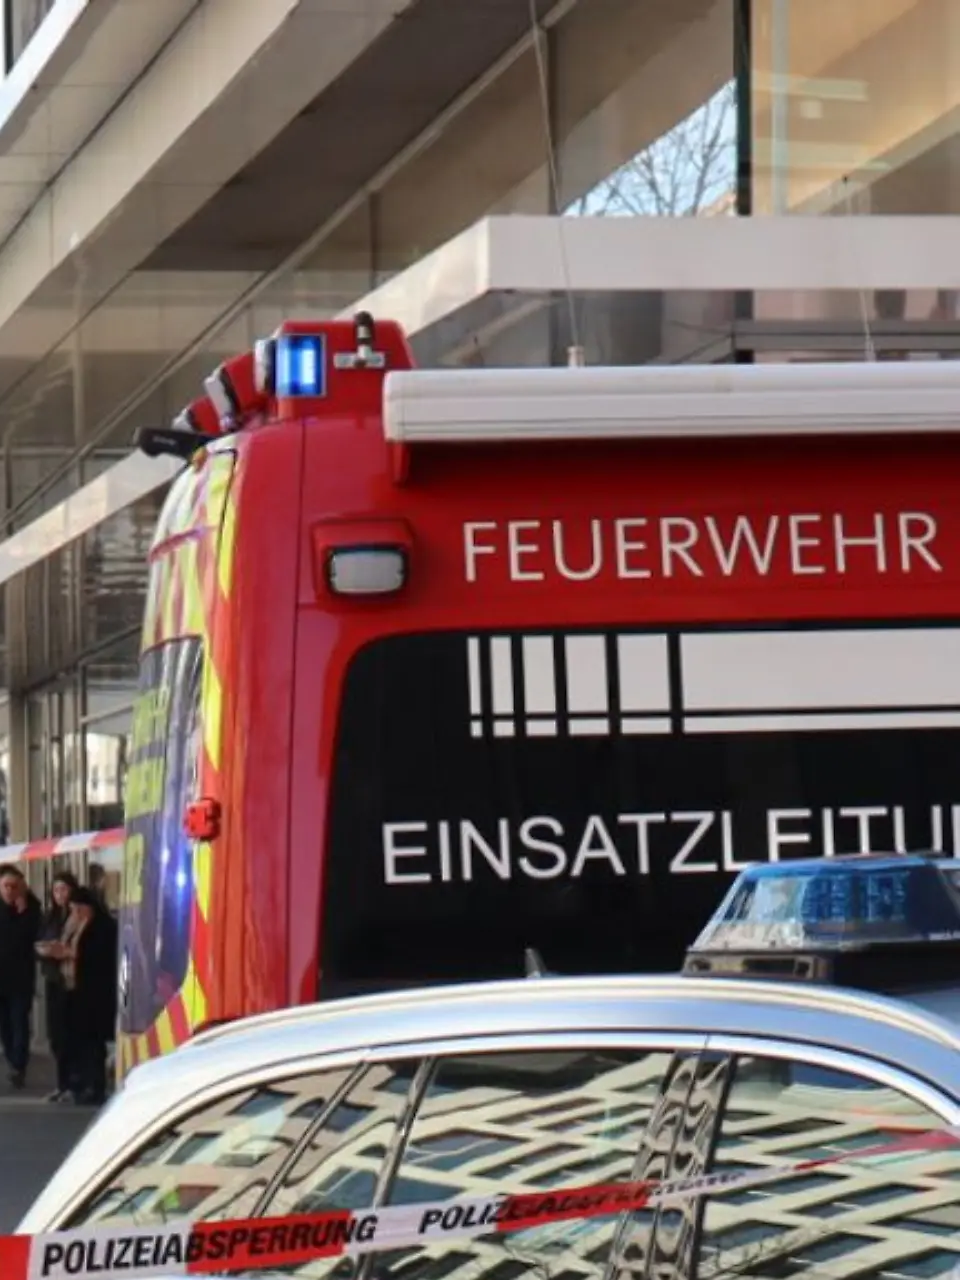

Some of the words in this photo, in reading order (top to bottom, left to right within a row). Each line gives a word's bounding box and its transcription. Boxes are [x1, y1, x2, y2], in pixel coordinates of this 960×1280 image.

[462, 511, 943, 582] FEUERWEHR
[382, 805, 960, 885] EINSATZLEITU
[42, 1215, 379, 1277] POLIZEIABSPERRUNG
